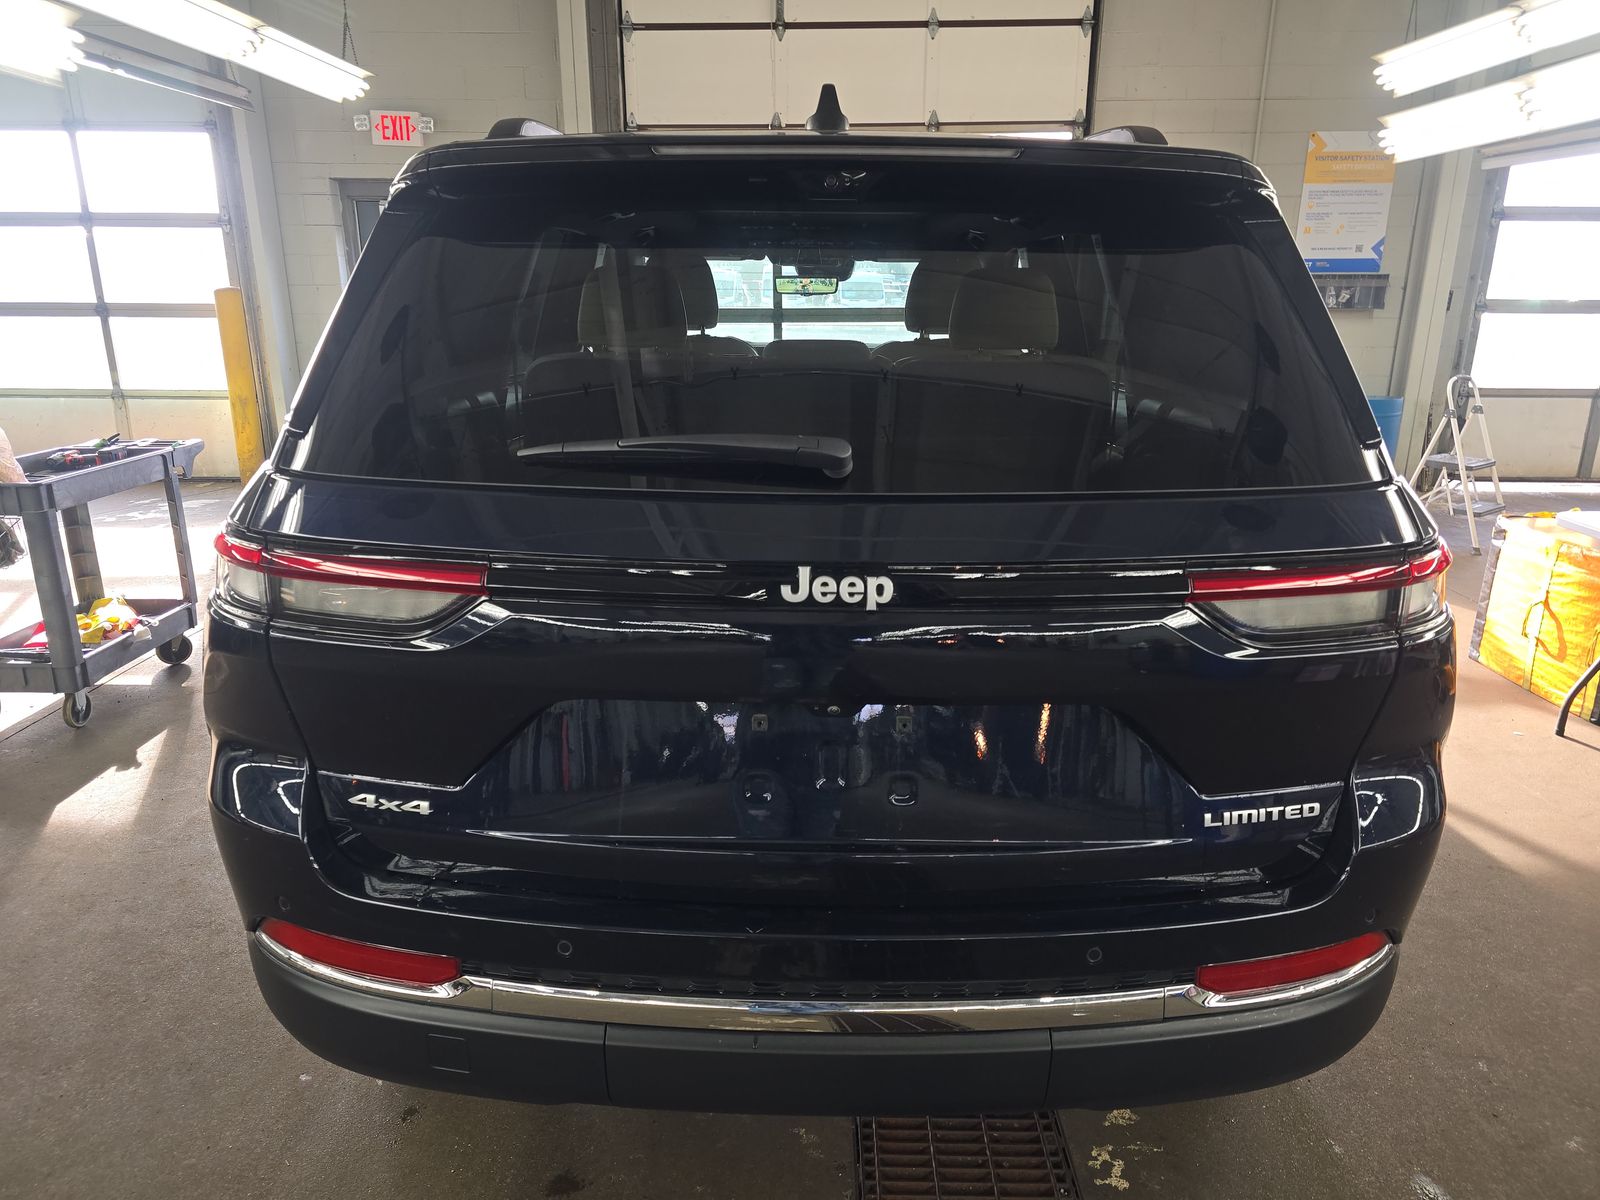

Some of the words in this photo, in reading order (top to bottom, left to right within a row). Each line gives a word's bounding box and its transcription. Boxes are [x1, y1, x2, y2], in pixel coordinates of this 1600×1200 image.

[381, 115, 411, 141] EXIT
[780, 566, 894, 611] Jeep
[347, 793, 434, 815] 4x4
[1204, 802, 1320, 827] LIMITED
